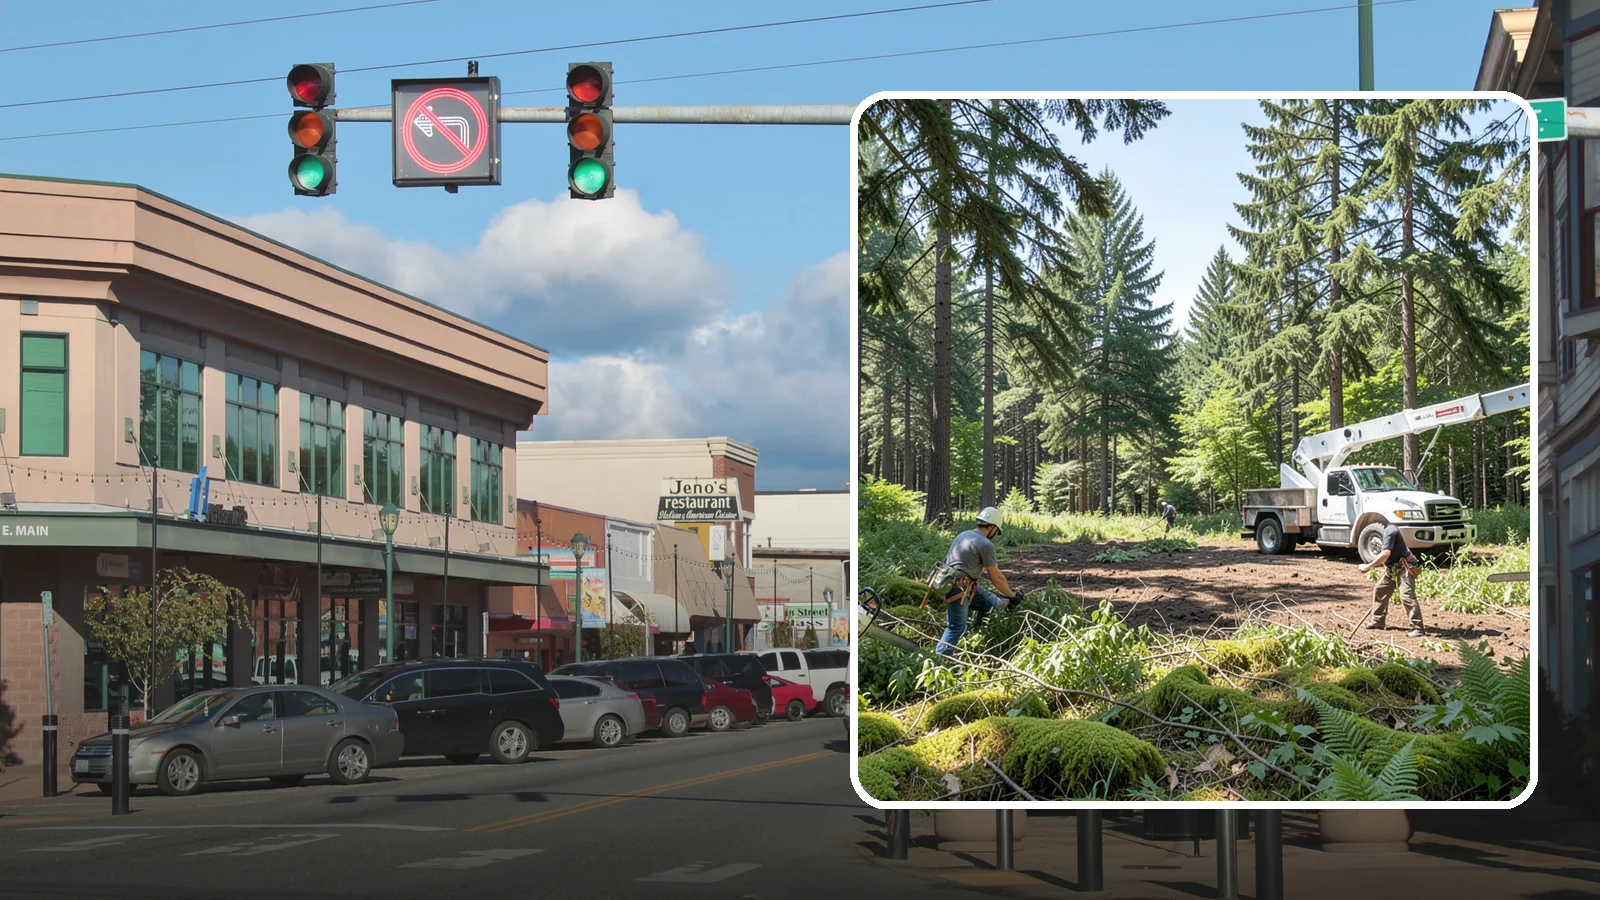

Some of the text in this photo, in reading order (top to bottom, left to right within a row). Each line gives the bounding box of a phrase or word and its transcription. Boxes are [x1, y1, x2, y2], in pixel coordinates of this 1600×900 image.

[669, 480, 728, 494] Jeno's
[664, 496, 731, 509] restaurant
[658, 509, 682, 520] Italian
[686, 509, 714, 519] American
[715, 509, 737, 519] Cuisine
[2, 525, 49, 536] E. MAIN
[797, 607, 828, 617] Street
[790, 619, 824, 627] lass
